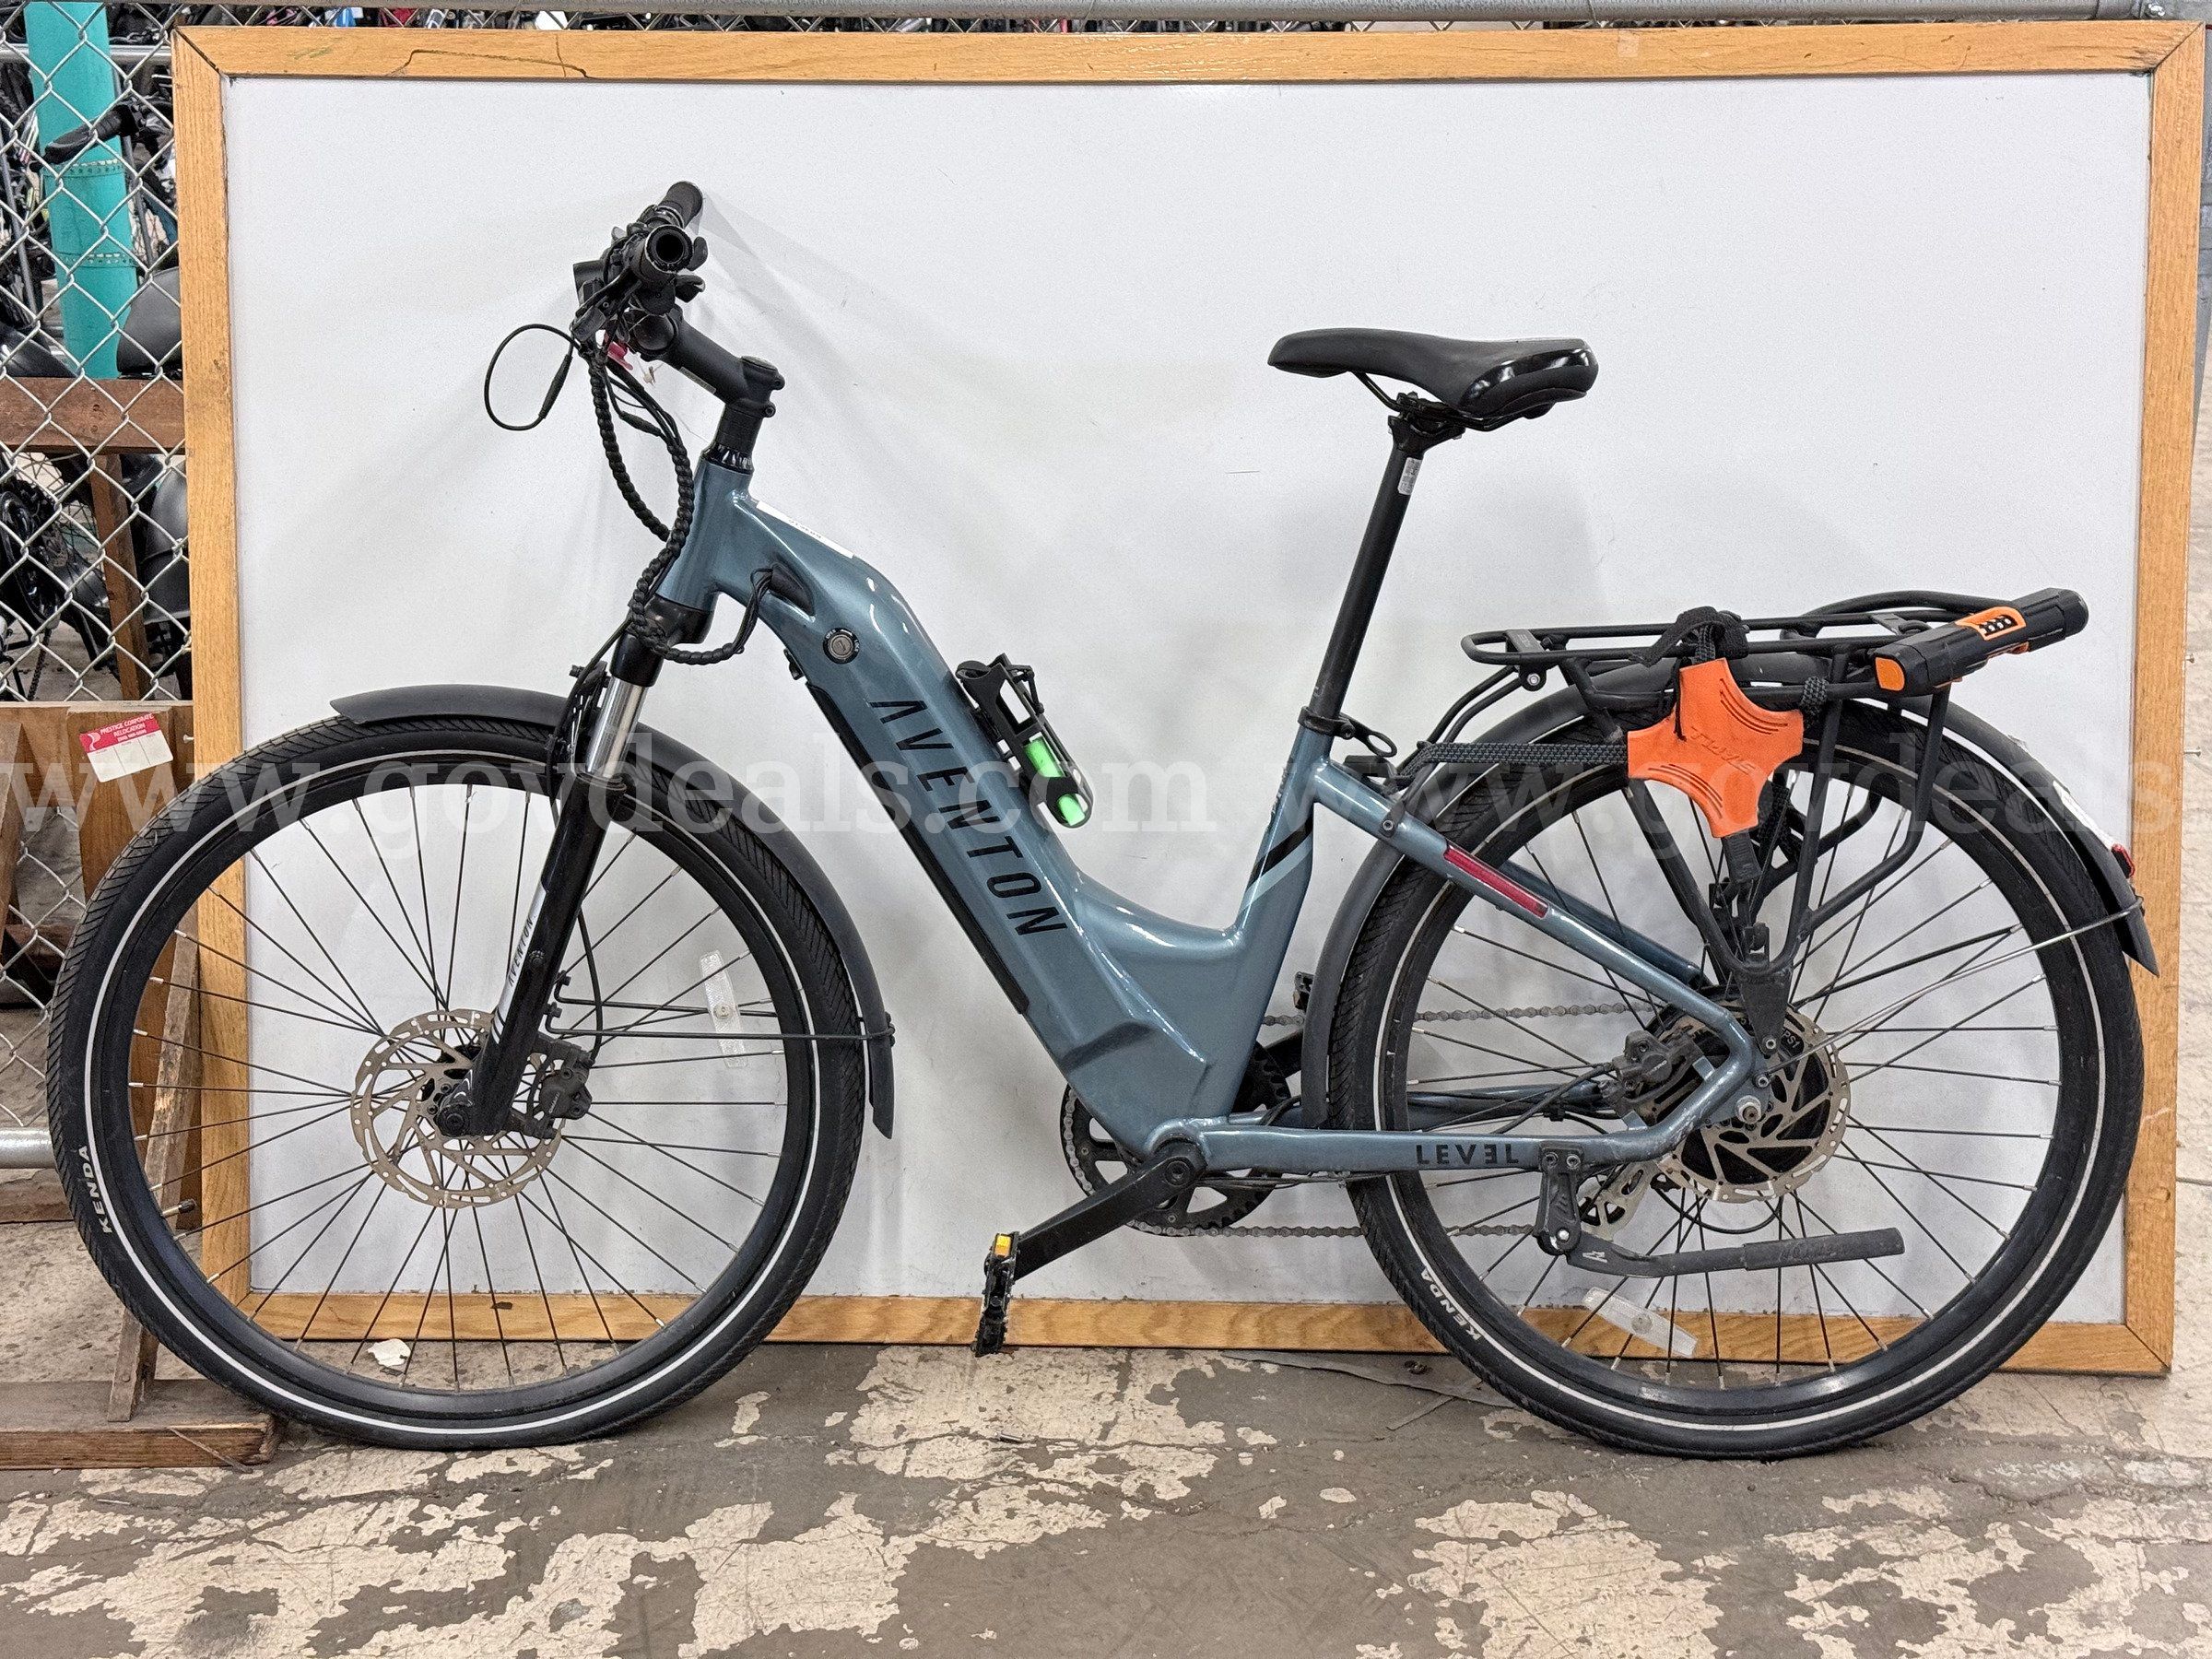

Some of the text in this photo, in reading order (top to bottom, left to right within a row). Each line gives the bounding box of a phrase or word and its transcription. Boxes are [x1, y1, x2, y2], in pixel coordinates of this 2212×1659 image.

[112, 722, 147, 737] RELOCATION
[869, 700, 1068, 935] AVENTON
[78, 1145, 113, 1233] KENDA
[1416, 1143, 1519, 1165] LEVEL
[1420, 1267, 1482, 1341] KENDA
